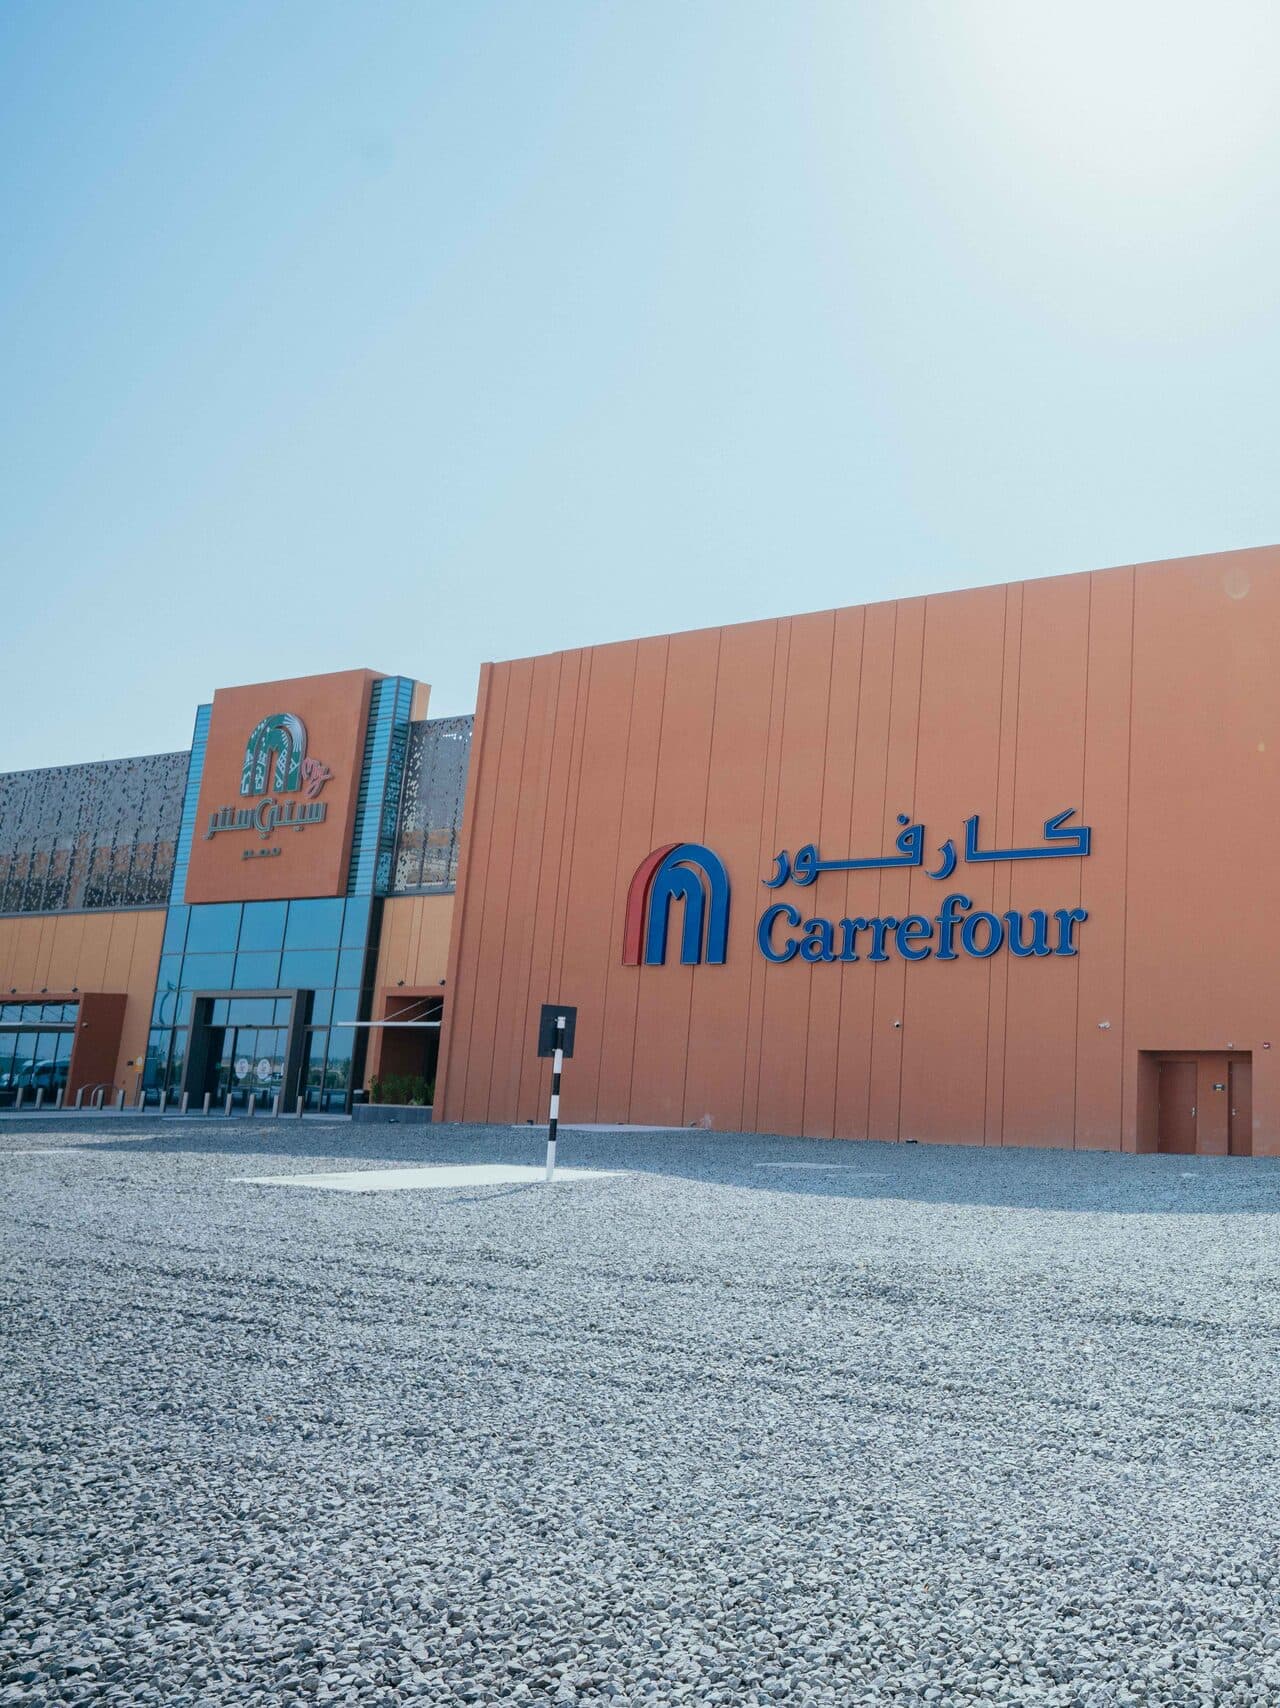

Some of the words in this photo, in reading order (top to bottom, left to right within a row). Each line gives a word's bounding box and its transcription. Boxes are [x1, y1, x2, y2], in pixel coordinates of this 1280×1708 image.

[302, 757, 335, 799] My
[761, 807, 1092, 888] كارفور
[756, 893, 1088, 964] Carrefour
